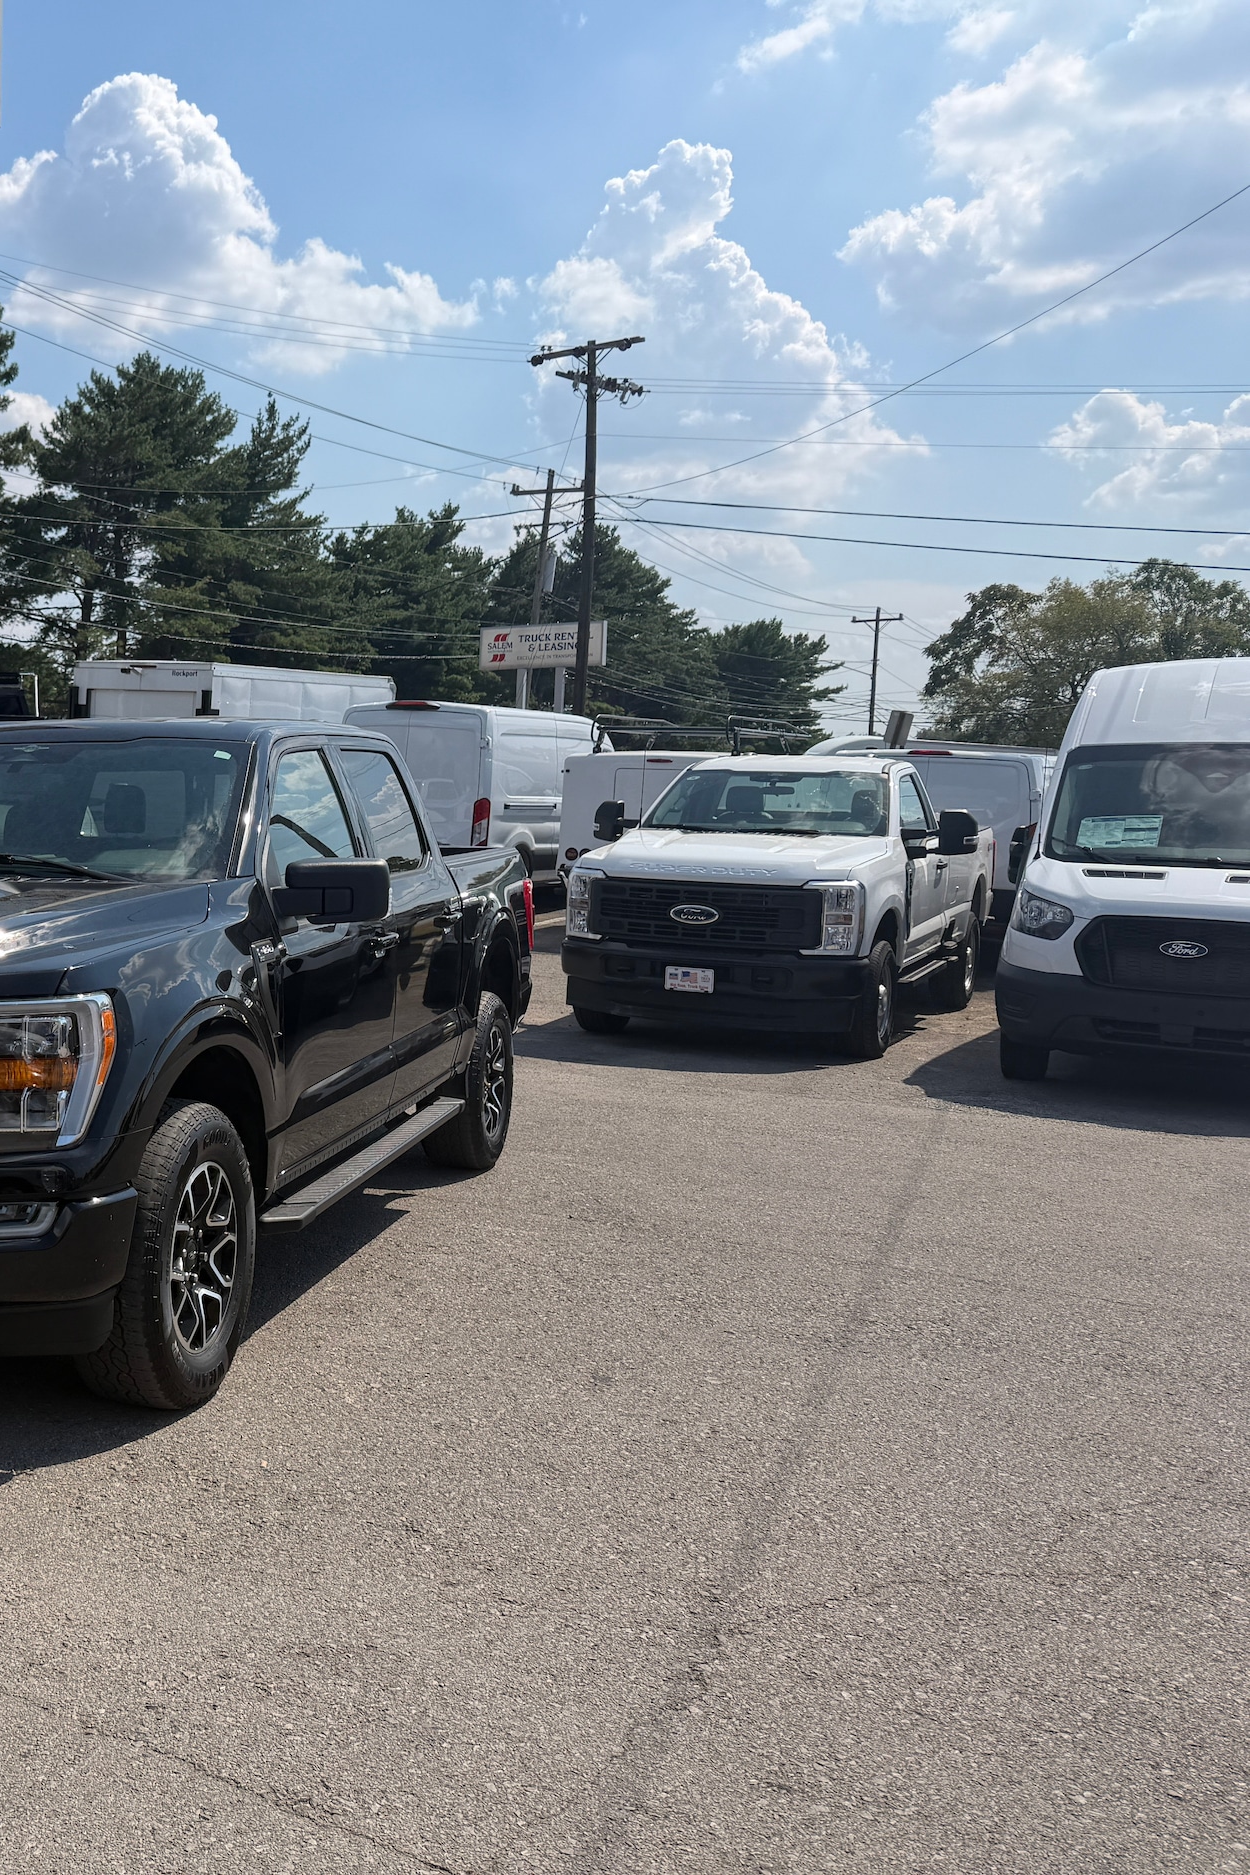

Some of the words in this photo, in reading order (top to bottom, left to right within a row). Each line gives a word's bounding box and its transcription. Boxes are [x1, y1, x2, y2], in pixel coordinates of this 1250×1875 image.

[518, 634, 551, 642] TRUCK
[487, 642, 513, 650] SALEM
[528, 644, 535, 652] &
[172, 669, 198, 678] Rockport
[629, 862, 707, 875] SUPER
[711, 866, 778, 877] DUTY
[680, 907, 707, 921] Ford
[1168, 943, 1199, 955] Ford
